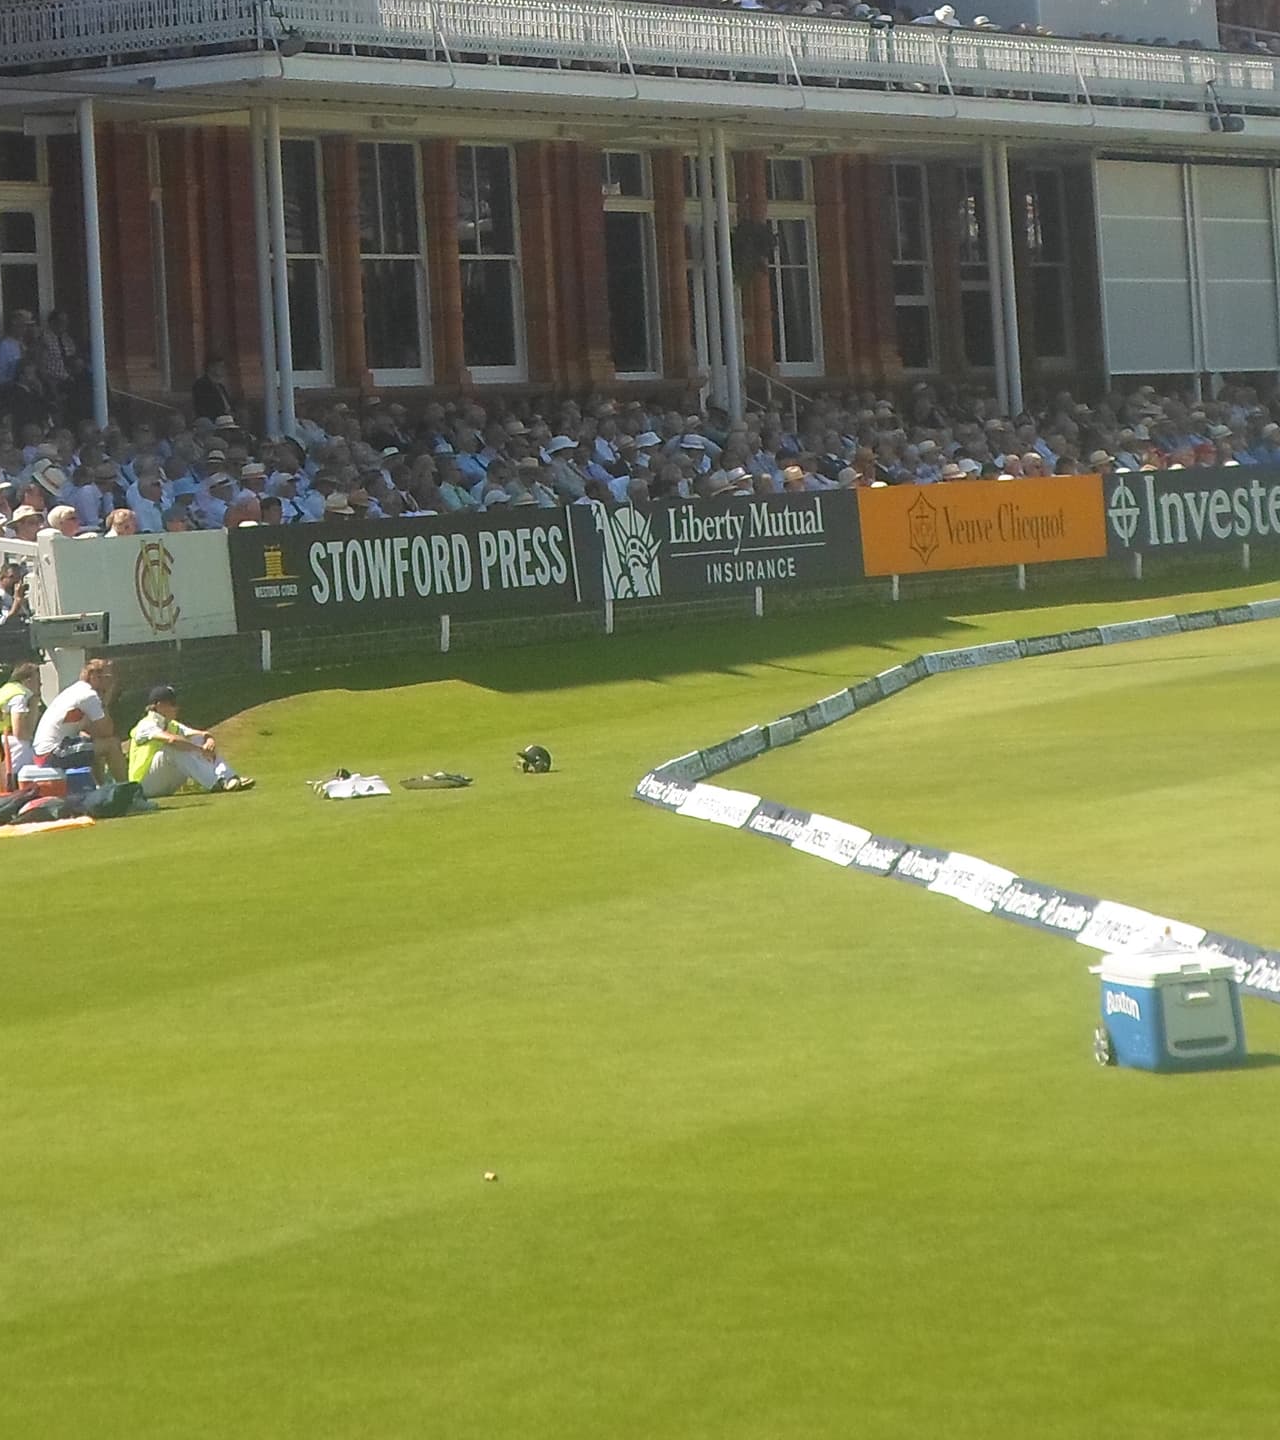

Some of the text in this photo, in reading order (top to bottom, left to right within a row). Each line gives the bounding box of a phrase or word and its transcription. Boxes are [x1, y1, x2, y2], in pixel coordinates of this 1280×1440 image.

[668, 496, 825, 556] Liberty Mutual
[943, 502, 1066, 549] Veuve Clicquot
[309, 525, 568, 604] STOWFORD PRESS
[706, 557, 797, 584] INSURANCE
